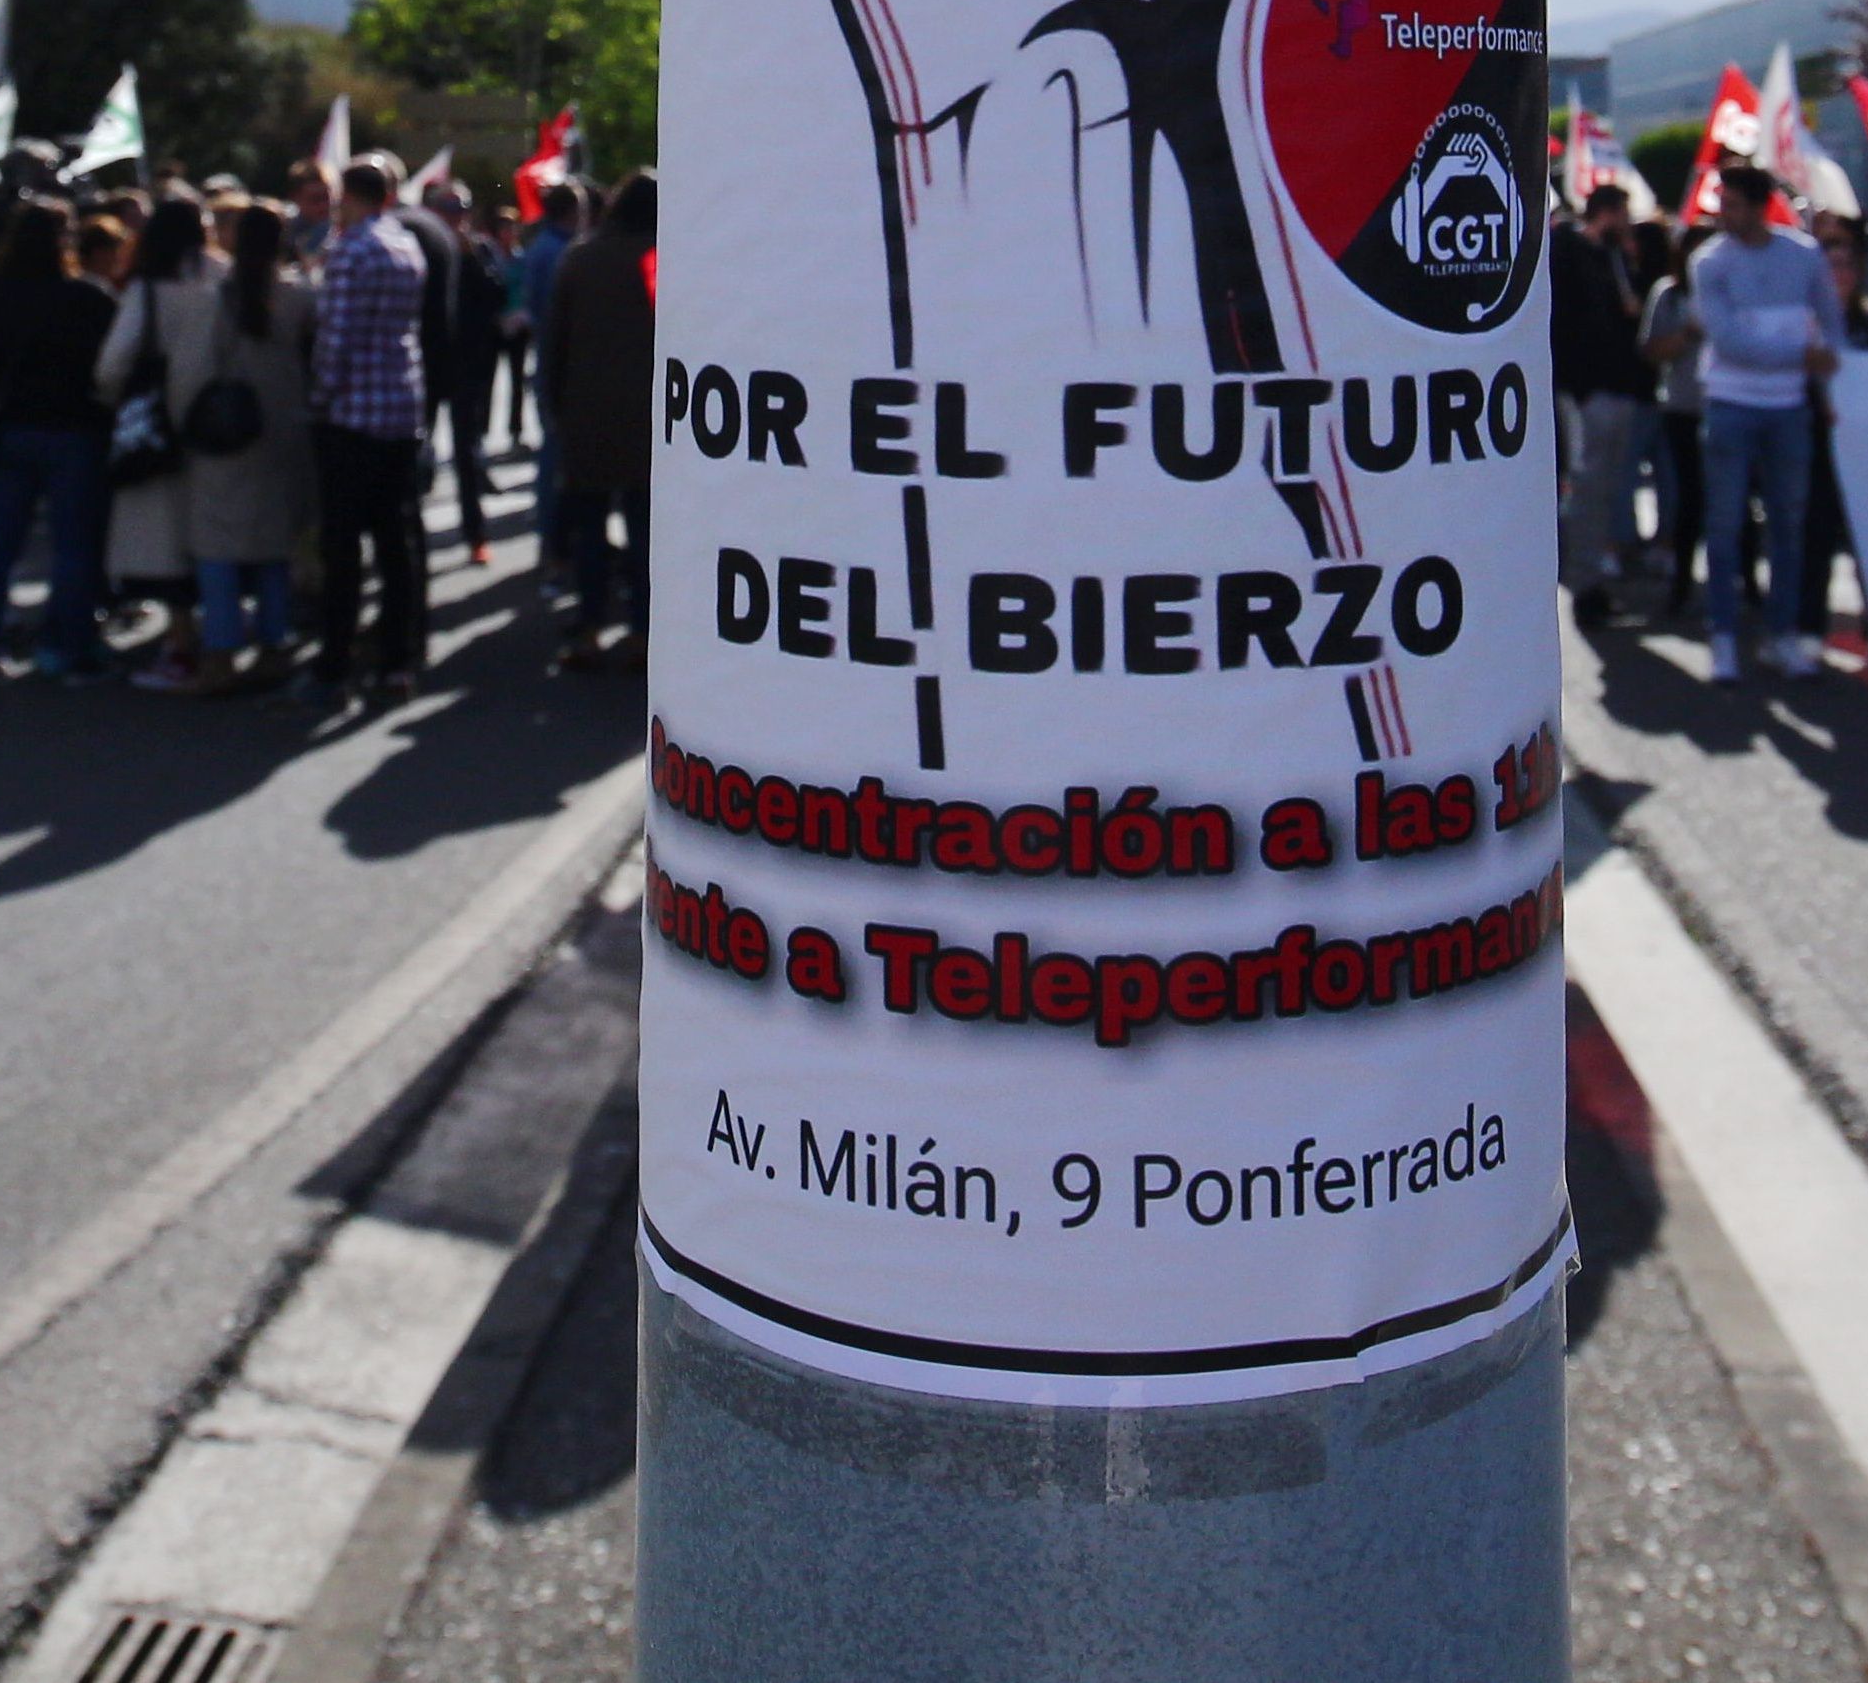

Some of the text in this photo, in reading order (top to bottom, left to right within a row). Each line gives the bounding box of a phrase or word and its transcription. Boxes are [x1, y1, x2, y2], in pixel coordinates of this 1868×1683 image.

[1380, 12, 1544, 60] Teleperformance
[1427, 213, 1504, 262] CGT
[665, 357, 1529, 483] POR EL FUTURO
[717, 547, 1464, 675] DEL BIERZO
[1260, 796, 1334, 872] a
[1354, 770, 1476, 862] las
[786, 926, 847, 1002] a
[707, 1088, 1507, 1237] Av. Milán, 9 Ponferrada
